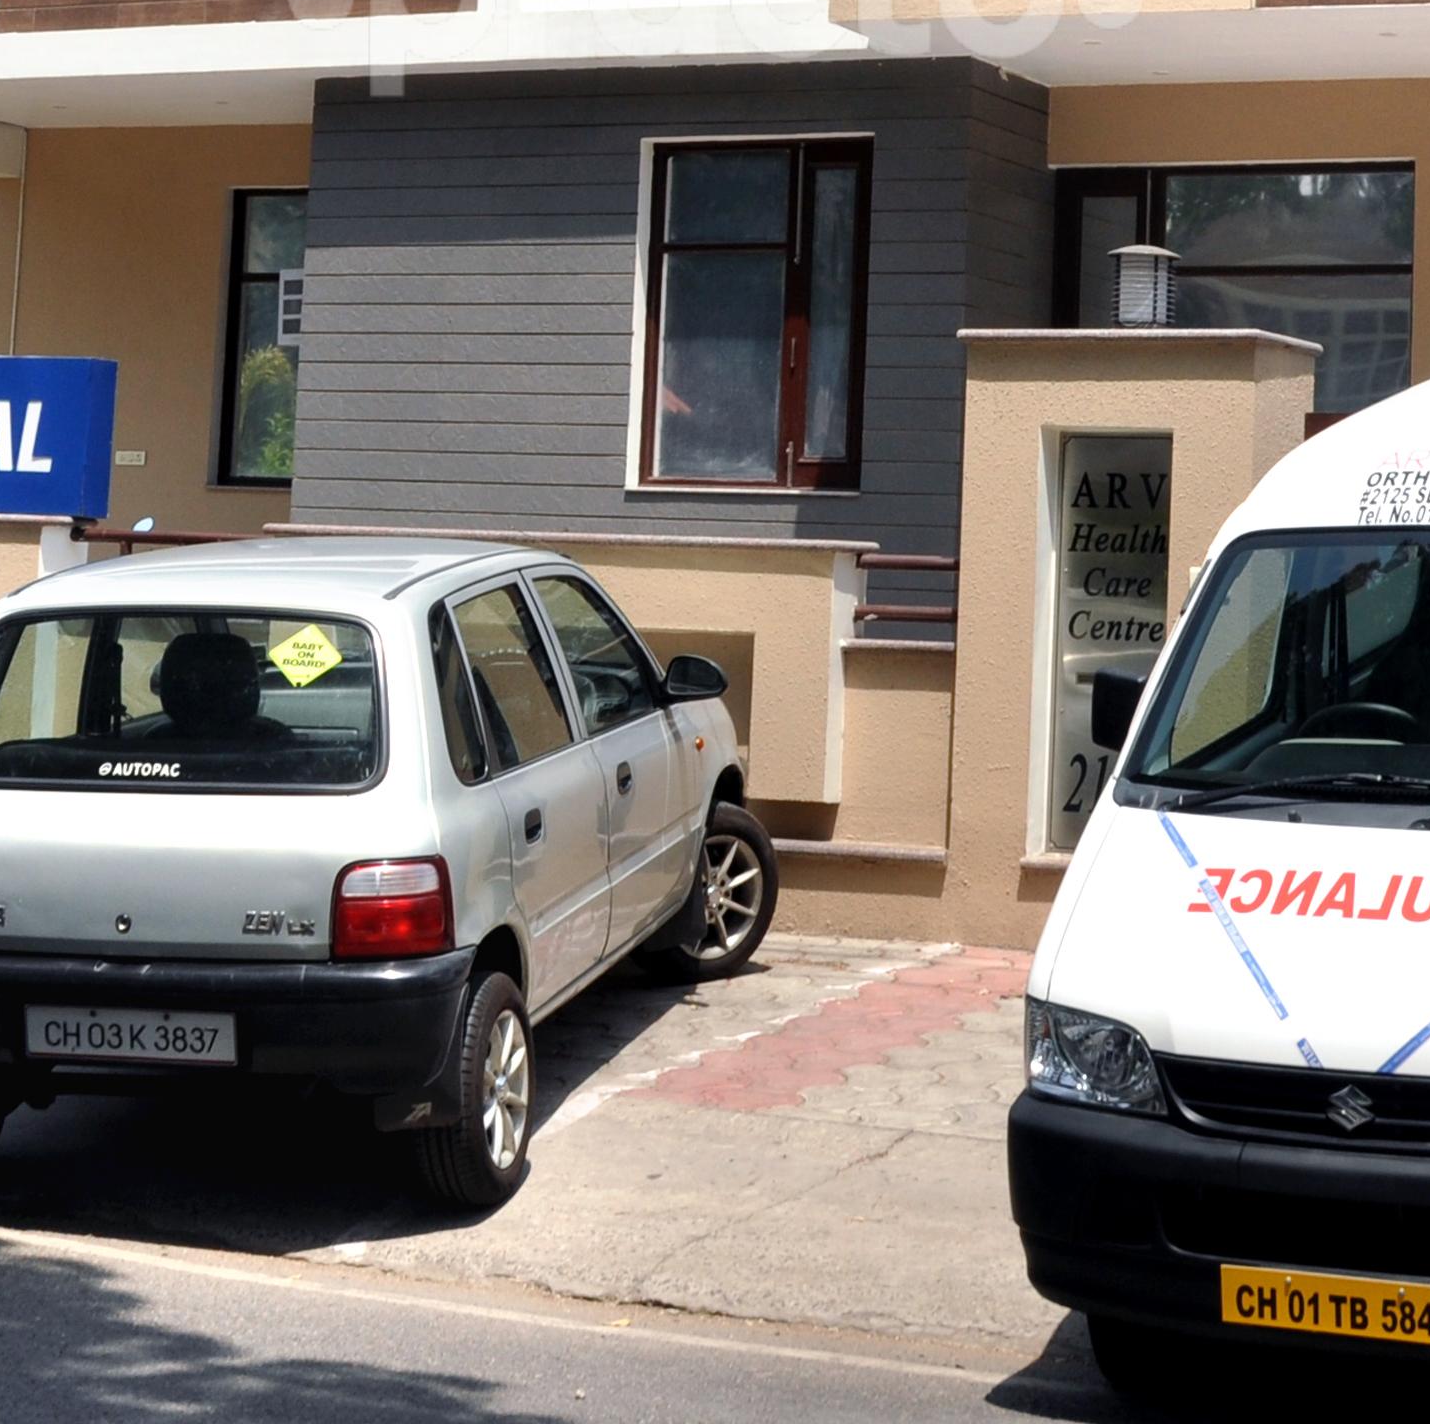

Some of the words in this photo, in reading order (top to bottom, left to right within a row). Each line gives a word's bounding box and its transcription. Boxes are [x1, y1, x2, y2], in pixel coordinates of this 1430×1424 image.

[1360, 487, 1411, 505] #2125
[1358, 505, 1382, 525] Tel.
[1068, 523, 1168, 554] Health
[1083, 568, 1152, 598] Care
[1068, 610, 1164, 642] Centre
[1062, 752, 1113, 814] 21
[242, 910, 285, 936] ZEN
[44, 1020, 81, 1048] CH
[87, 1022, 123, 1050] 03
[129, 1024, 147, 1051] K
[154, 1025, 219, 1054] 3837
[1235, 1284, 1277, 1321] CH
[1288, 1289, 1320, 1326] 01
[1328, 1294, 1369, 1331] TB
